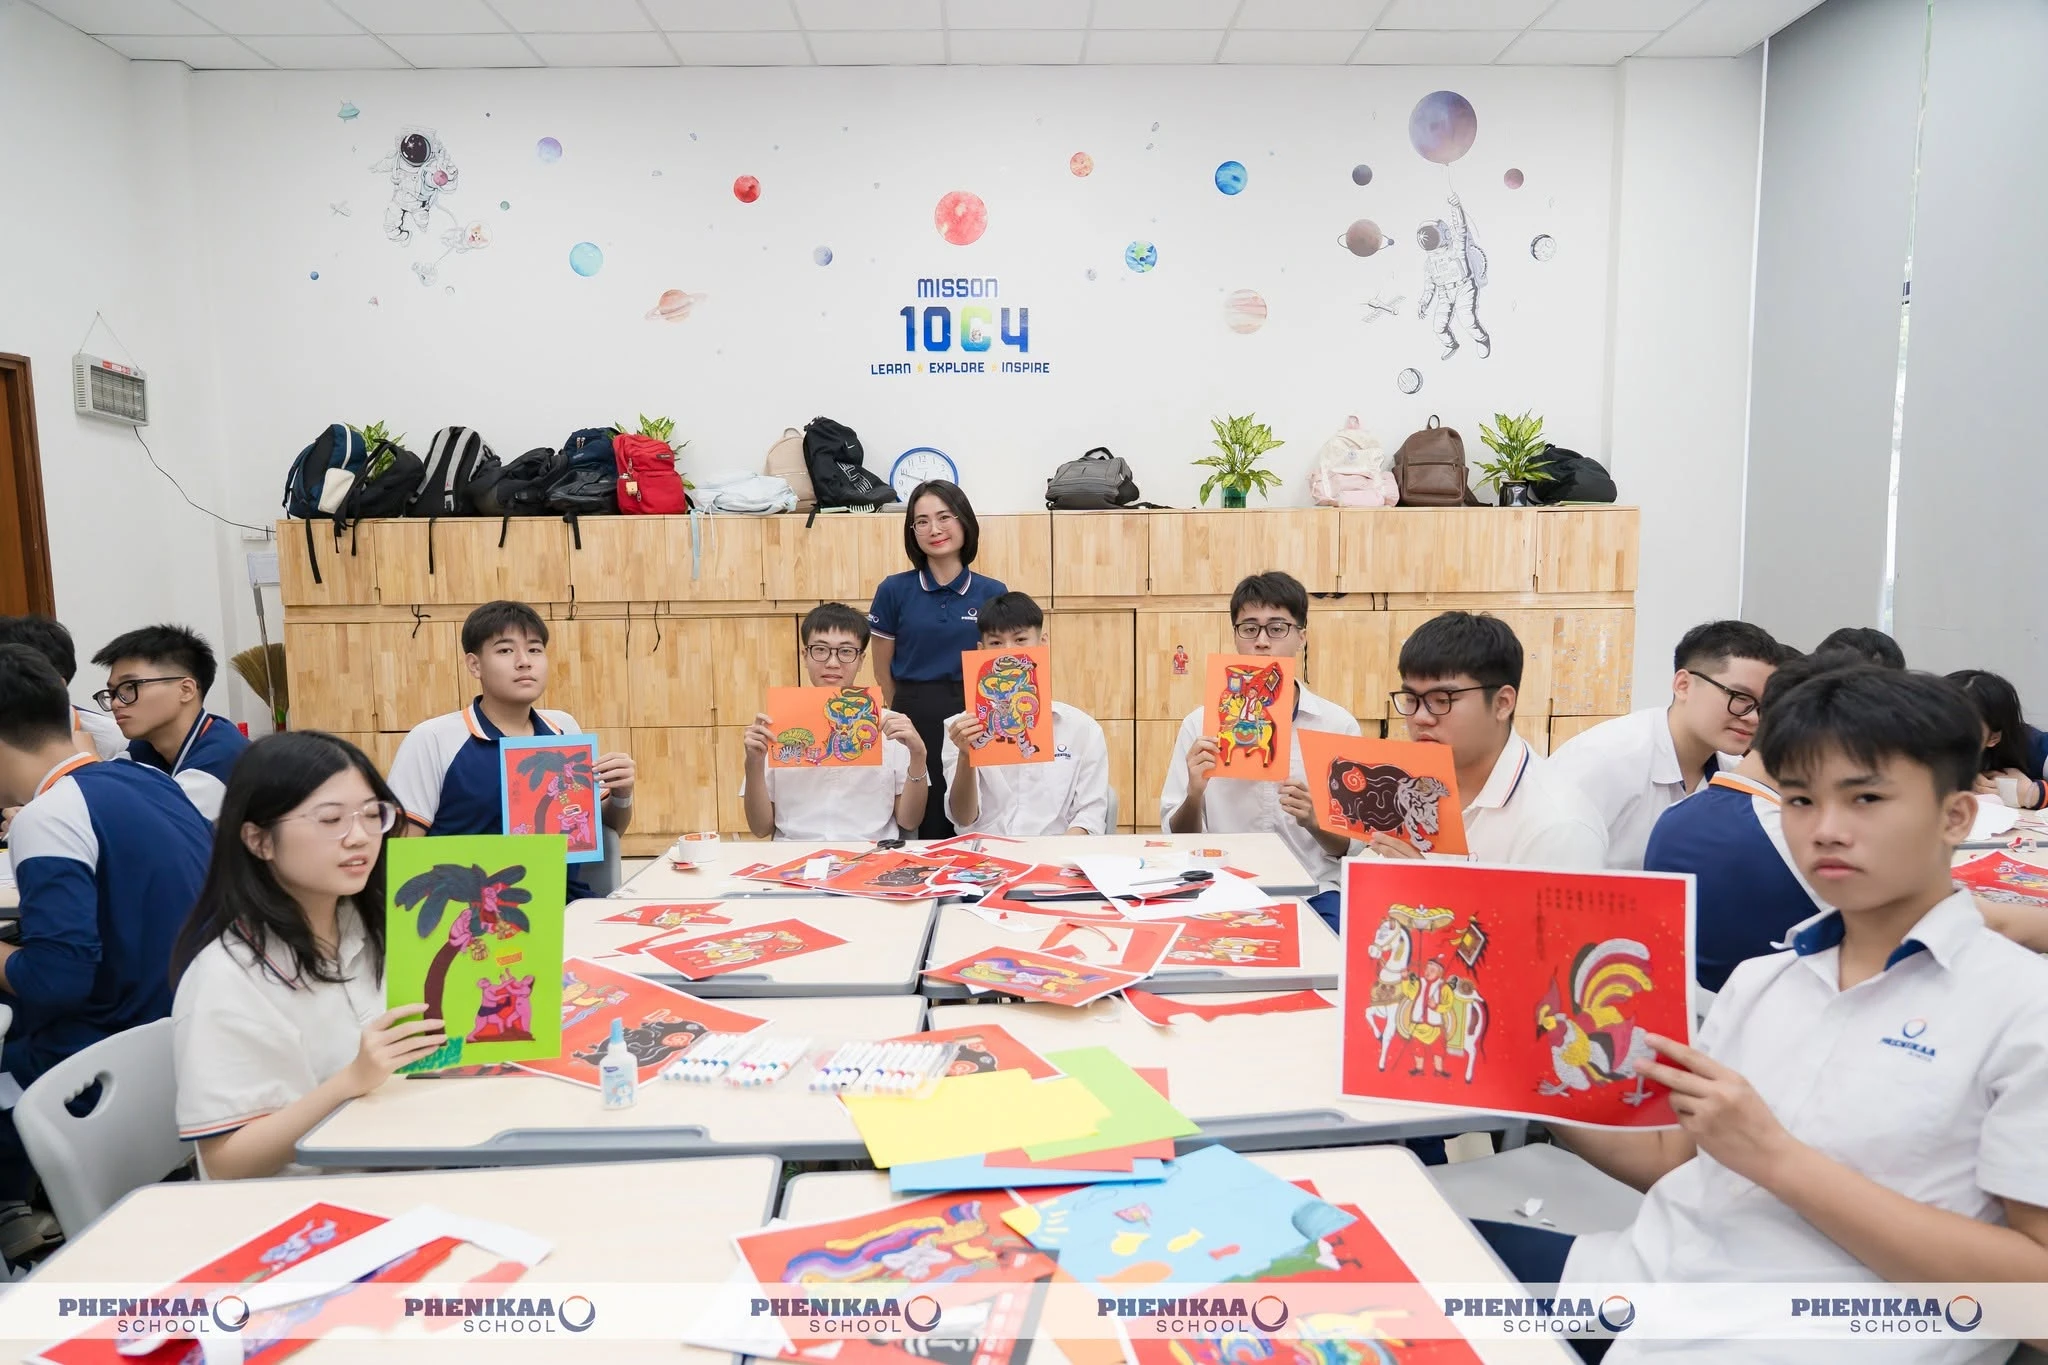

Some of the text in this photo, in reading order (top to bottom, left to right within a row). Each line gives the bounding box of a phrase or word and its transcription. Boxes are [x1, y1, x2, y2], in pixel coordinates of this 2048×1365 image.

[917, 278, 998, 298] MISSON
[900, 306, 1029, 353] 10C4
[871, 362, 1050, 375] LEARN EXPLORE INSPIRE
